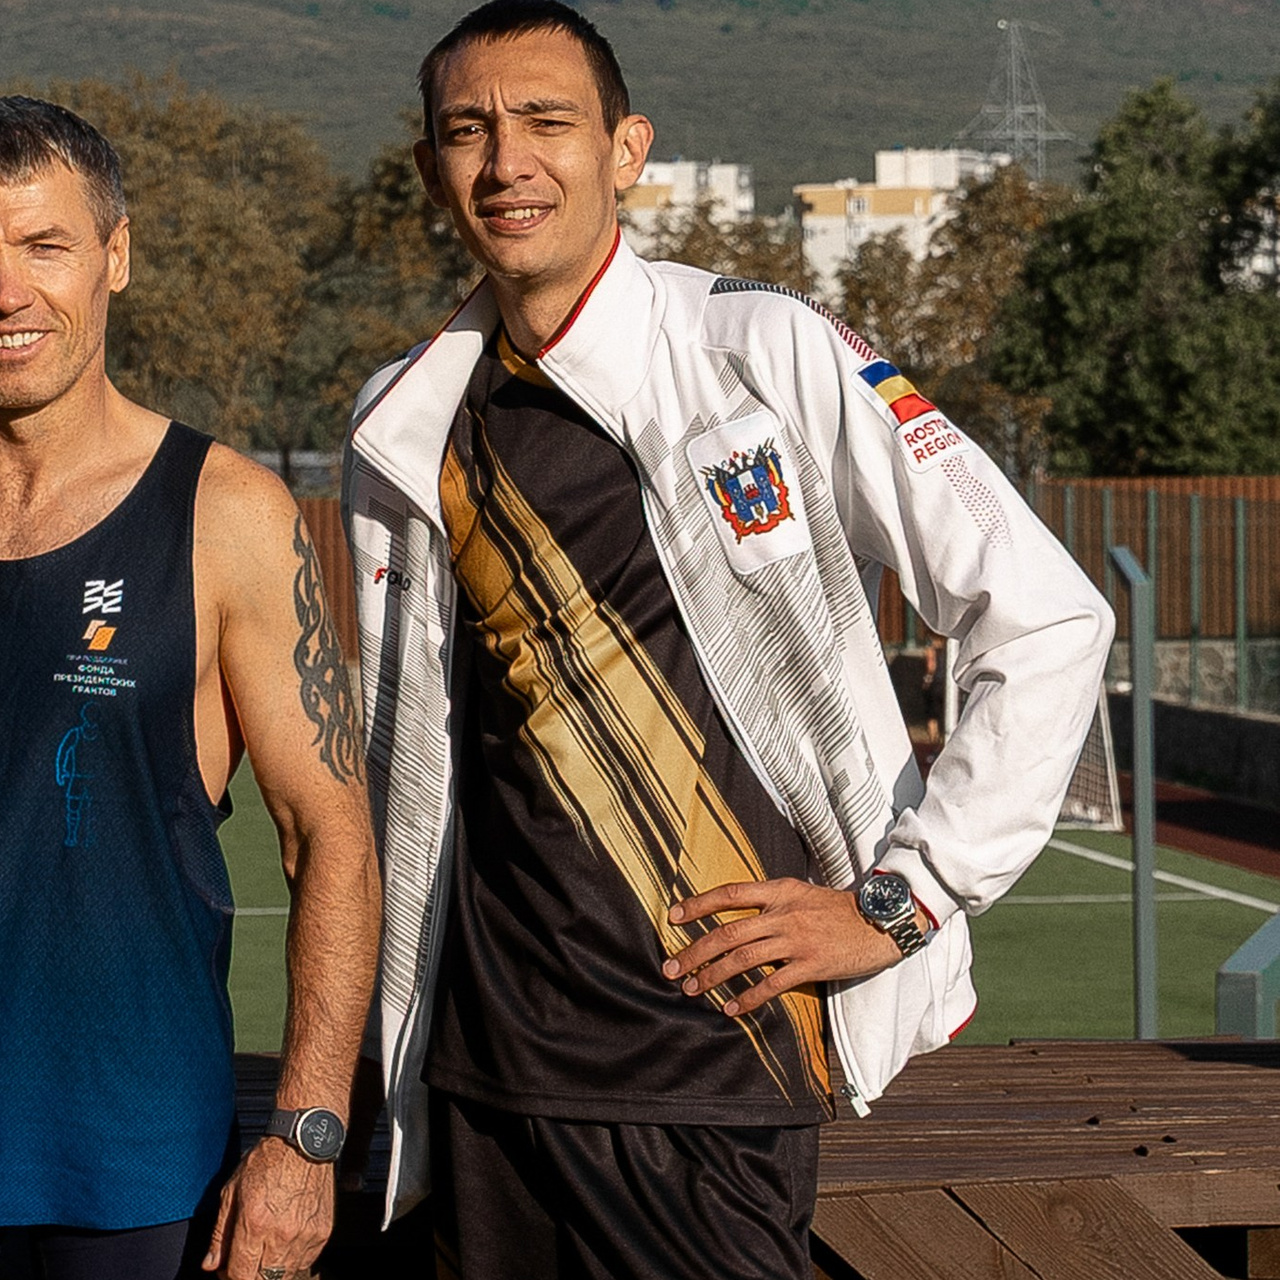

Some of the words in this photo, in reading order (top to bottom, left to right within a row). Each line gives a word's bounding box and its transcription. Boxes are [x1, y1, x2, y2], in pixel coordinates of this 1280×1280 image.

[903, 418, 949, 448] ROSTO
[913, 431, 964, 464] REGION
[78, 664, 115, 675] ФОНДА
